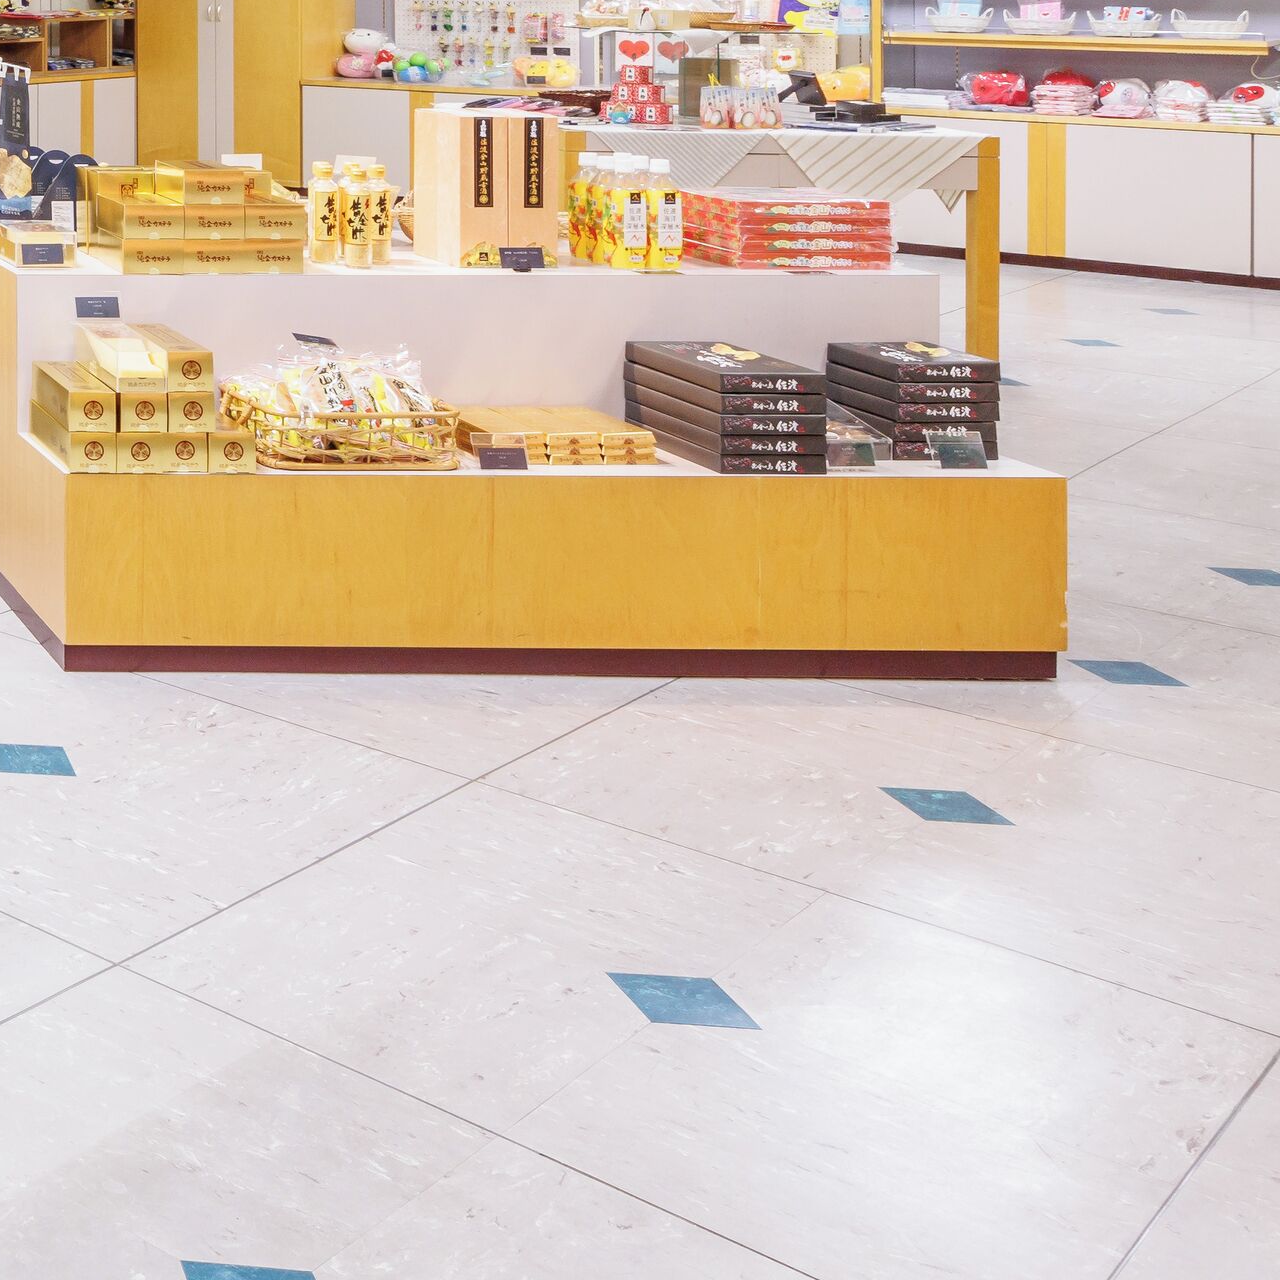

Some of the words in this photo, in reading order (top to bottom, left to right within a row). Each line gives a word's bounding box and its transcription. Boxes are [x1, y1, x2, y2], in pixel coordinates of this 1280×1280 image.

[950, 366, 972, 377] 佐渡
[775, 379, 798, 391] 佐渡
[949, 387, 971, 399] 佐渡
[777, 400, 799, 411] 佐渡
[950, 406, 971, 417] 佐渡
[777, 420, 799, 432] 佐渡
[775, 441, 798, 452] 佐渡
[775, 460, 798, 472] 佐渡
